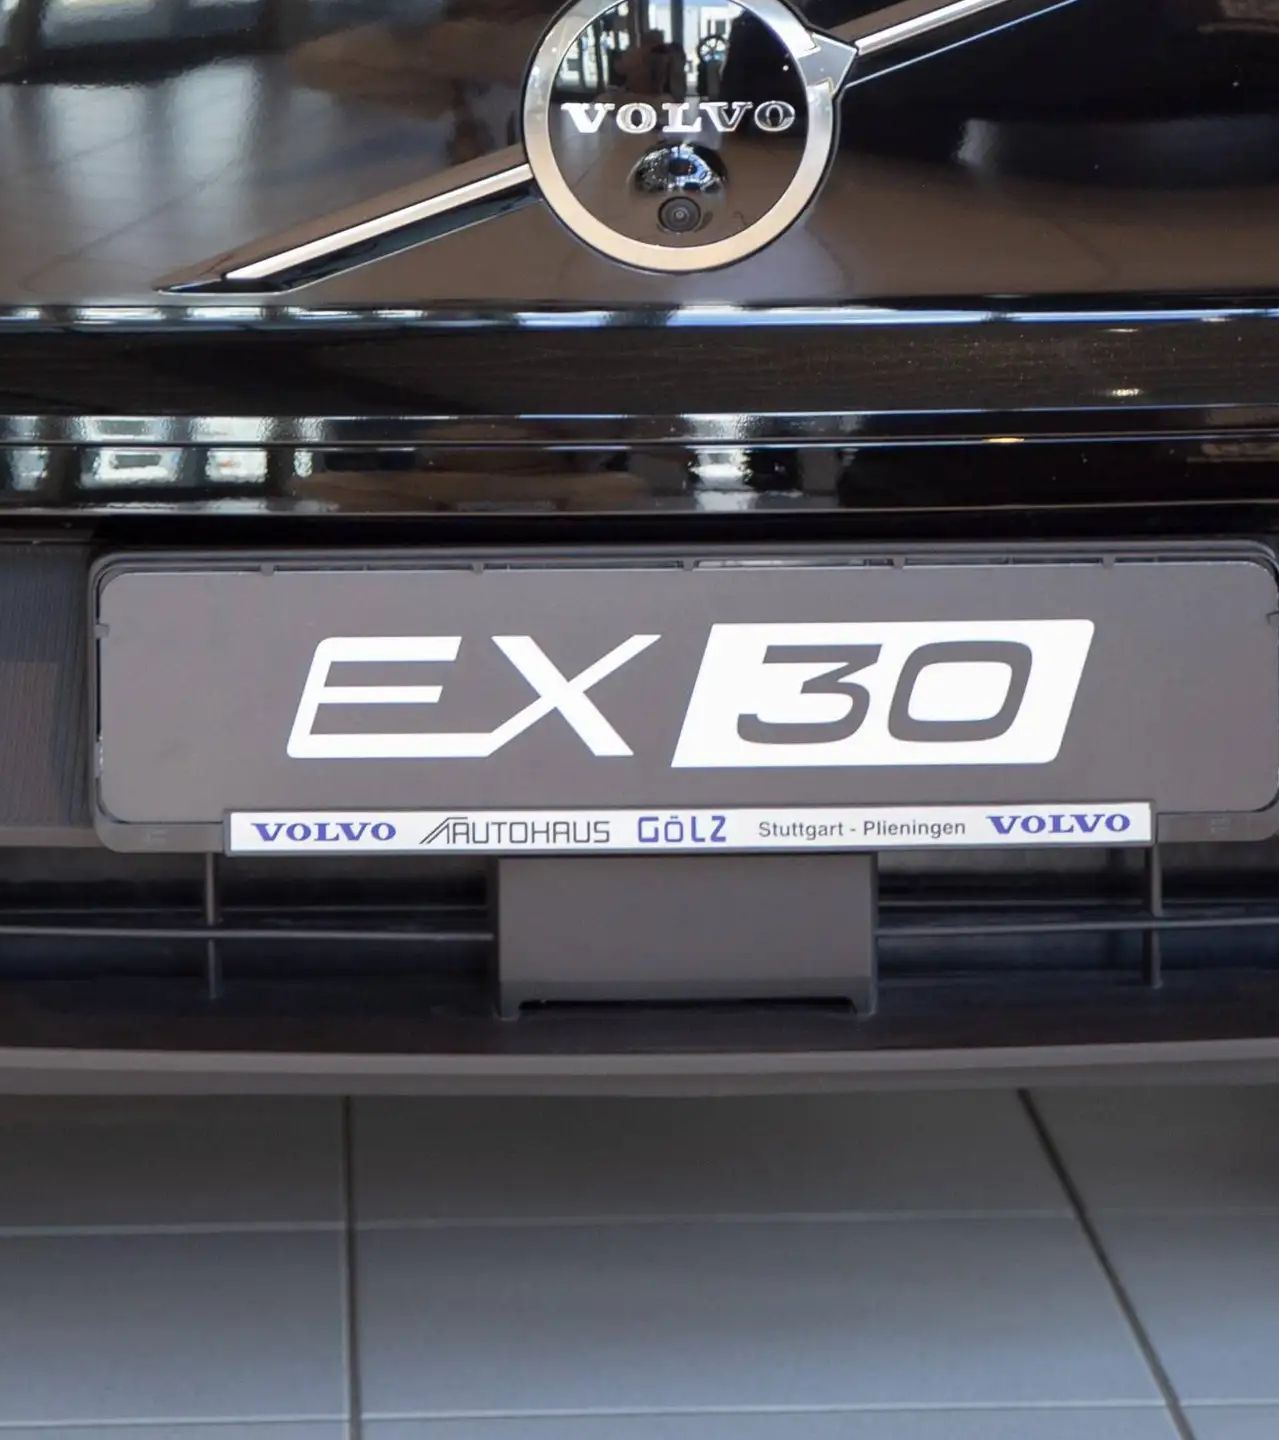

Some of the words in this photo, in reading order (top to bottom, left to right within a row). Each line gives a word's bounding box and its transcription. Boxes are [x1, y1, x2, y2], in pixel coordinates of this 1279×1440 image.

[560, 100, 796, 135] VOLVO
[251, 821, 397, 842] VOLVO
[419, 816, 610, 845] AUTOHAUS
[637, 815, 727, 843] GÖLZ
[758, 821, 844, 841] Stuttgart
[863, 819, 966, 840] Plieningen
[986, 813, 1131, 835] VOLVO
